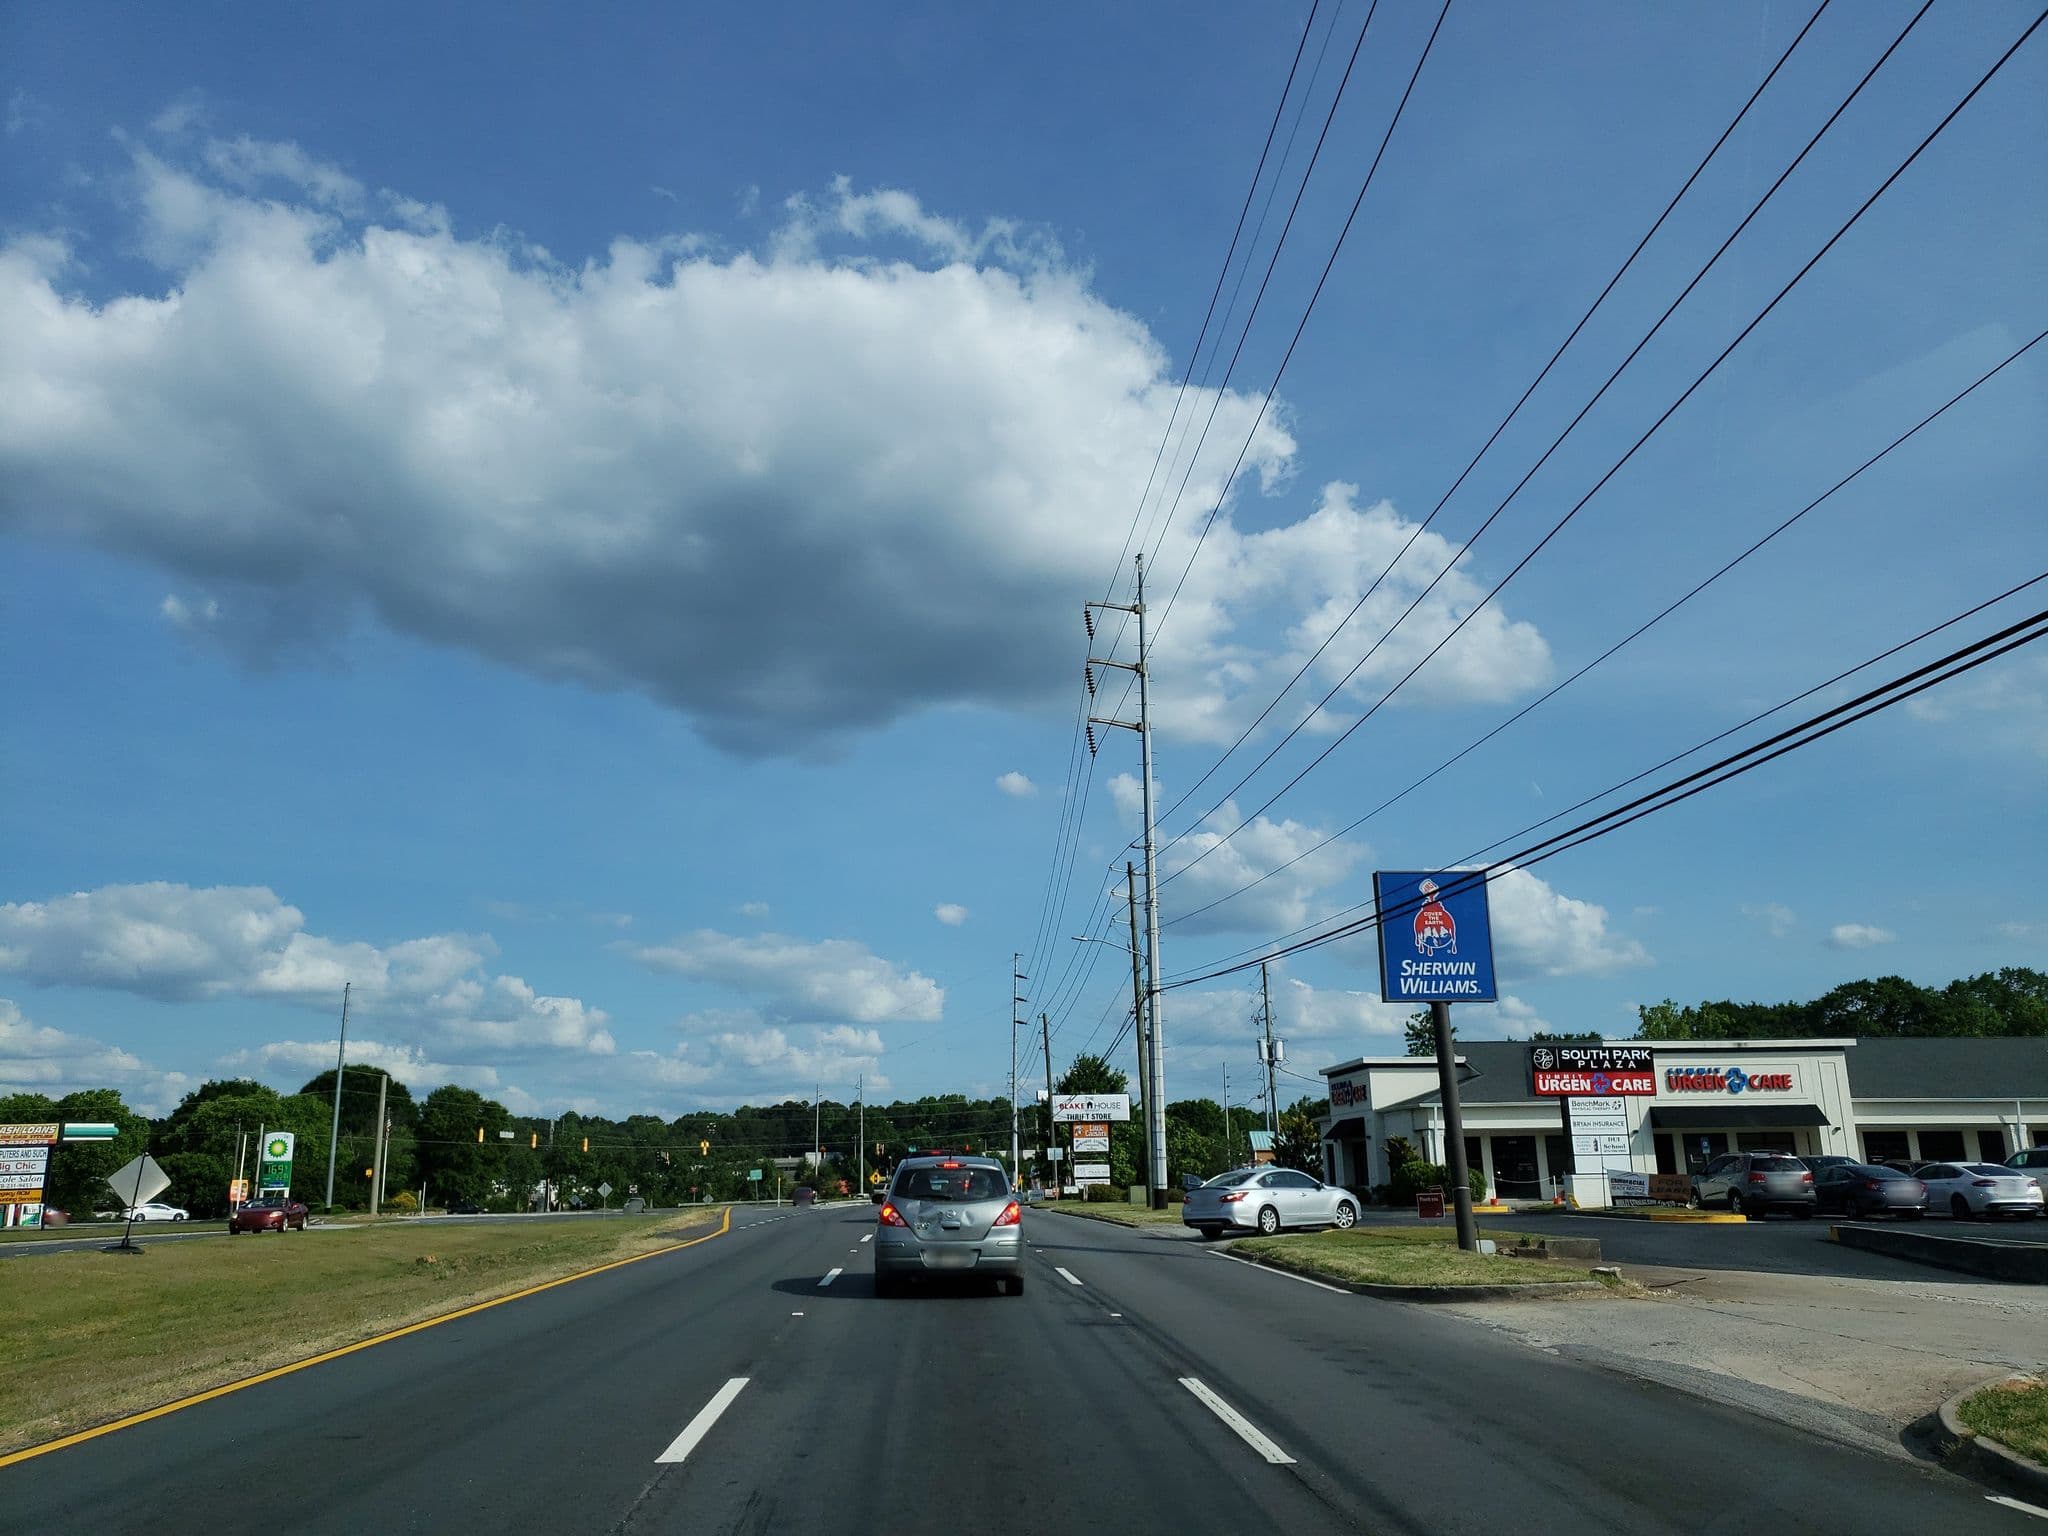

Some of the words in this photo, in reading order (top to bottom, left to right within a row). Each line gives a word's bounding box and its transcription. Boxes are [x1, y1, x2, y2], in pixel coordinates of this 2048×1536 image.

[1401, 960, 1476, 976] SHERWIN
[1400, 978, 1478, 994] WILLIAMS
[1561, 1050, 1609, 1060] SOUTH
[1612, 1050, 1651, 1060] PARK
[1578, 1060, 1637, 1068] PLAZA
[1666, 1067, 1721, 1075] SUMMIT
[1611, 1079, 1652, 1091] CARE
[1748, 1074, 1793, 1090] CARE
[1094, 1102, 1121, 1110] HOUSE
[1066, 1113, 1089, 1121] THRIFT
[22, 1126, 57, 1134] LOANS
[16, 1161, 36, 1169] Chic
[18, 1175, 42, 1183] Salon
